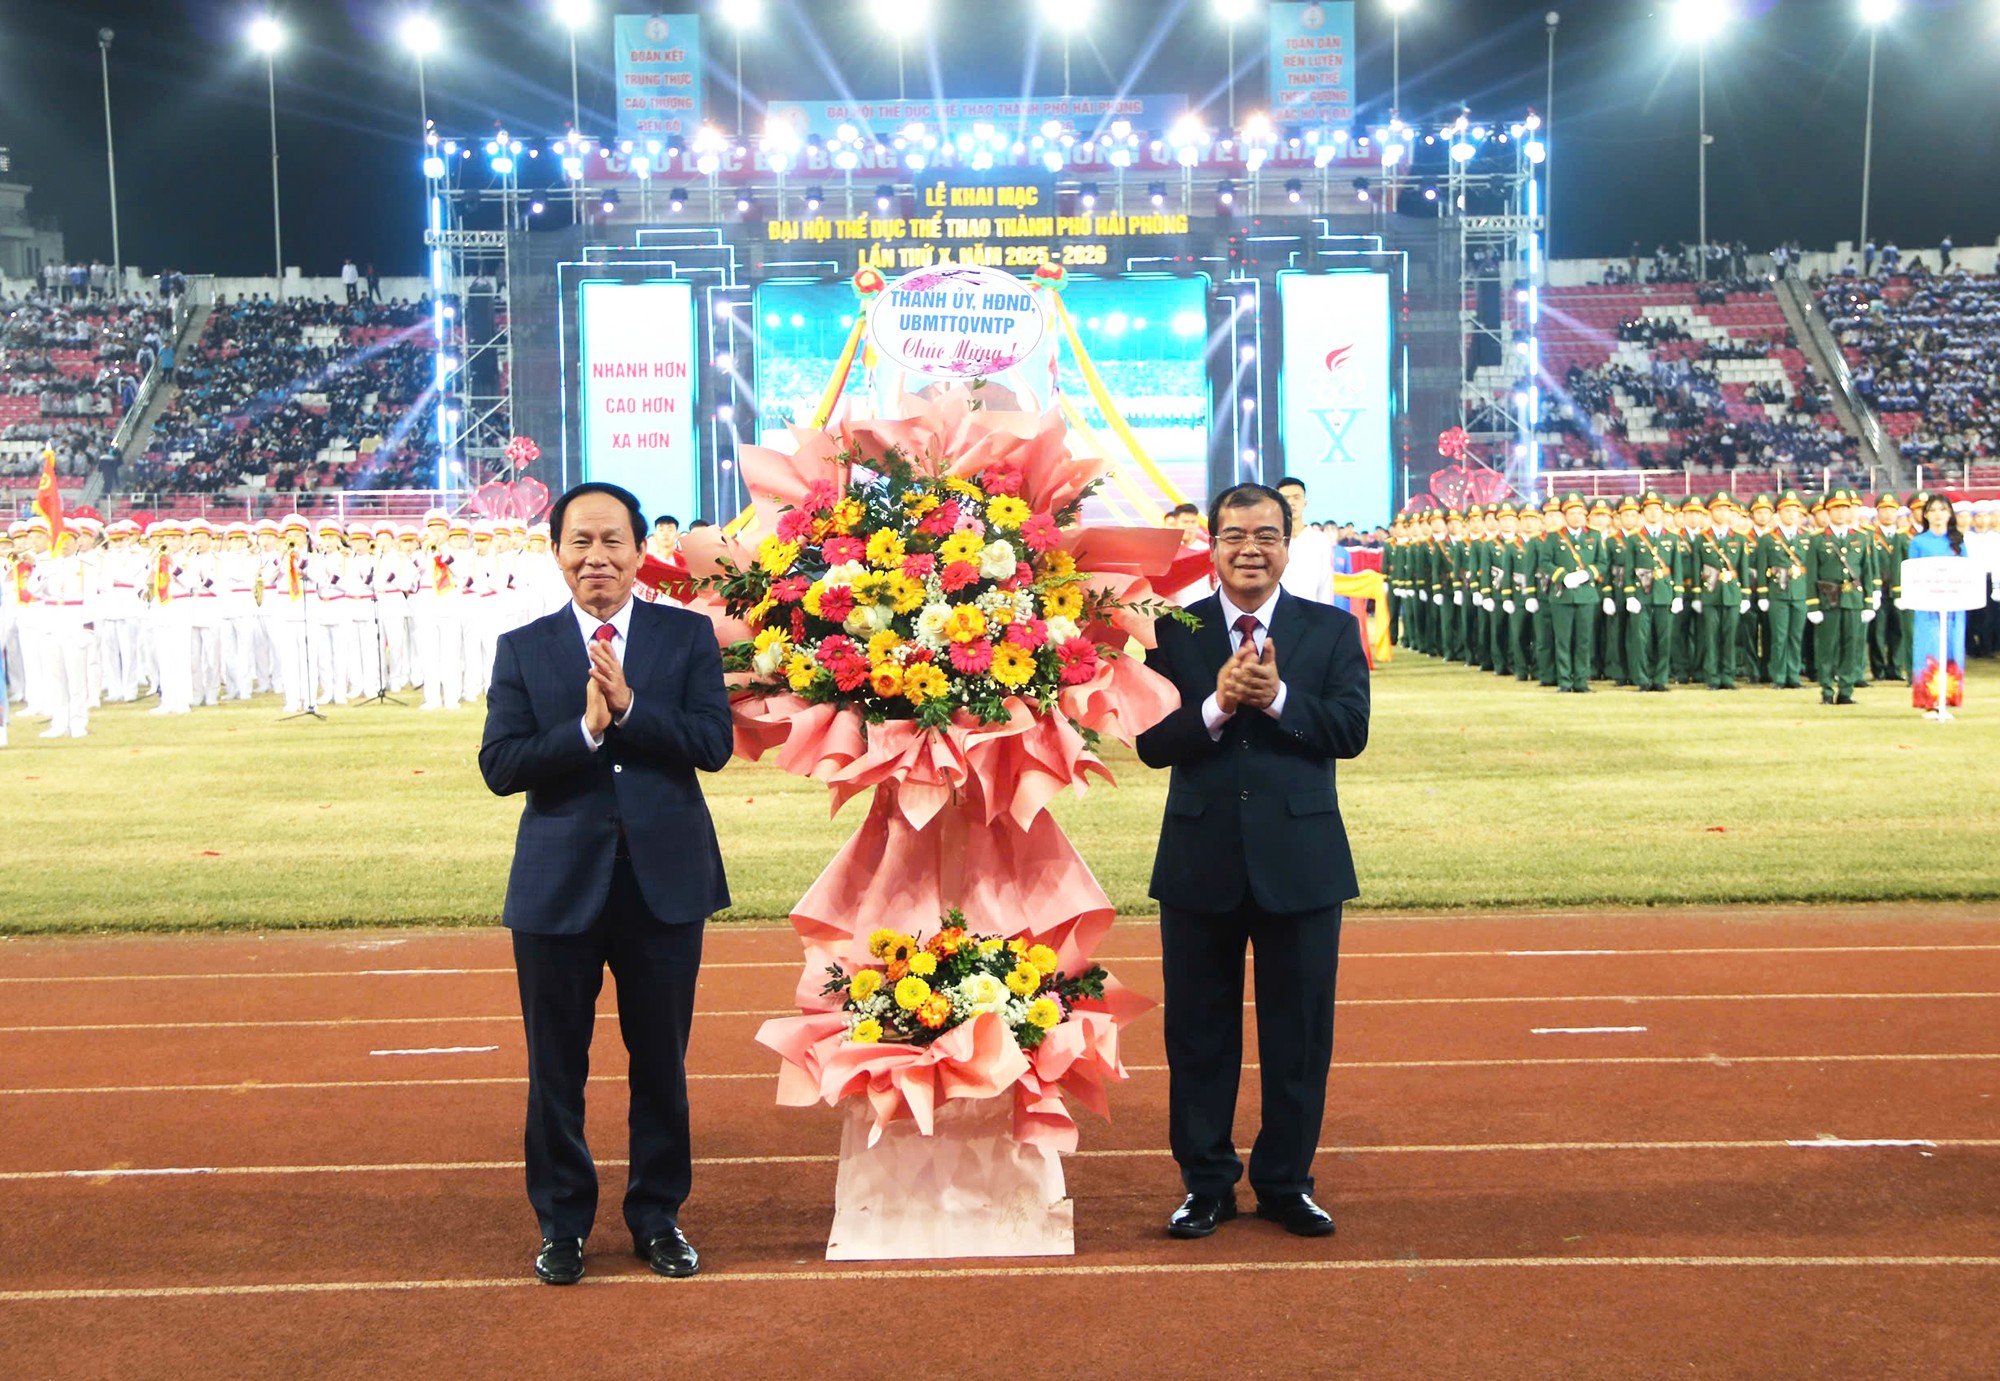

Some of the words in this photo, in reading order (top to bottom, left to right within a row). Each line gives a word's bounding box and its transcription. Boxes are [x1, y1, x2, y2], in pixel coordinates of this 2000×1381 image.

[624, 75, 660, 85] TRUNG
[624, 98, 646, 109] CAO
[681, 150, 744, 172] LC
[951, 187, 994, 206] KHAI
[998, 186, 1038, 209] MẠC
[768, 219, 799, 243] ĐẠI
[802, 215, 832, 243] HỘI
[835, 211, 869, 239] THỂ
[871, 218, 906, 242] DỤC
[909, 210, 943, 238] THỂ
[945, 218, 991, 238] THAO
[994, 214, 1054, 237] THÀNH
[1056, 211, 1095, 236] PHỐ
[1095, 210, 1126, 236] HẢI
[1129, 211, 1189, 235] PHÒNG
[959, 242, 1002, 266] NĂM
[1004, 246, 1049, 266] 2025
[1063, 245, 1107, 265] 2026
[982, 293, 1036, 314] HĐND,
[899, 314, 1015, 334] UBMTTQVNTP
[593, 363, 648, 378] NHANH
[654, 361, 686, 378] HƠN
[606, 398, 636, 413] CAO
[642, 397, 674, 413] HƠN
[612, 433, 631, 448] XA
[638, 432, 670, 448] HƠN
